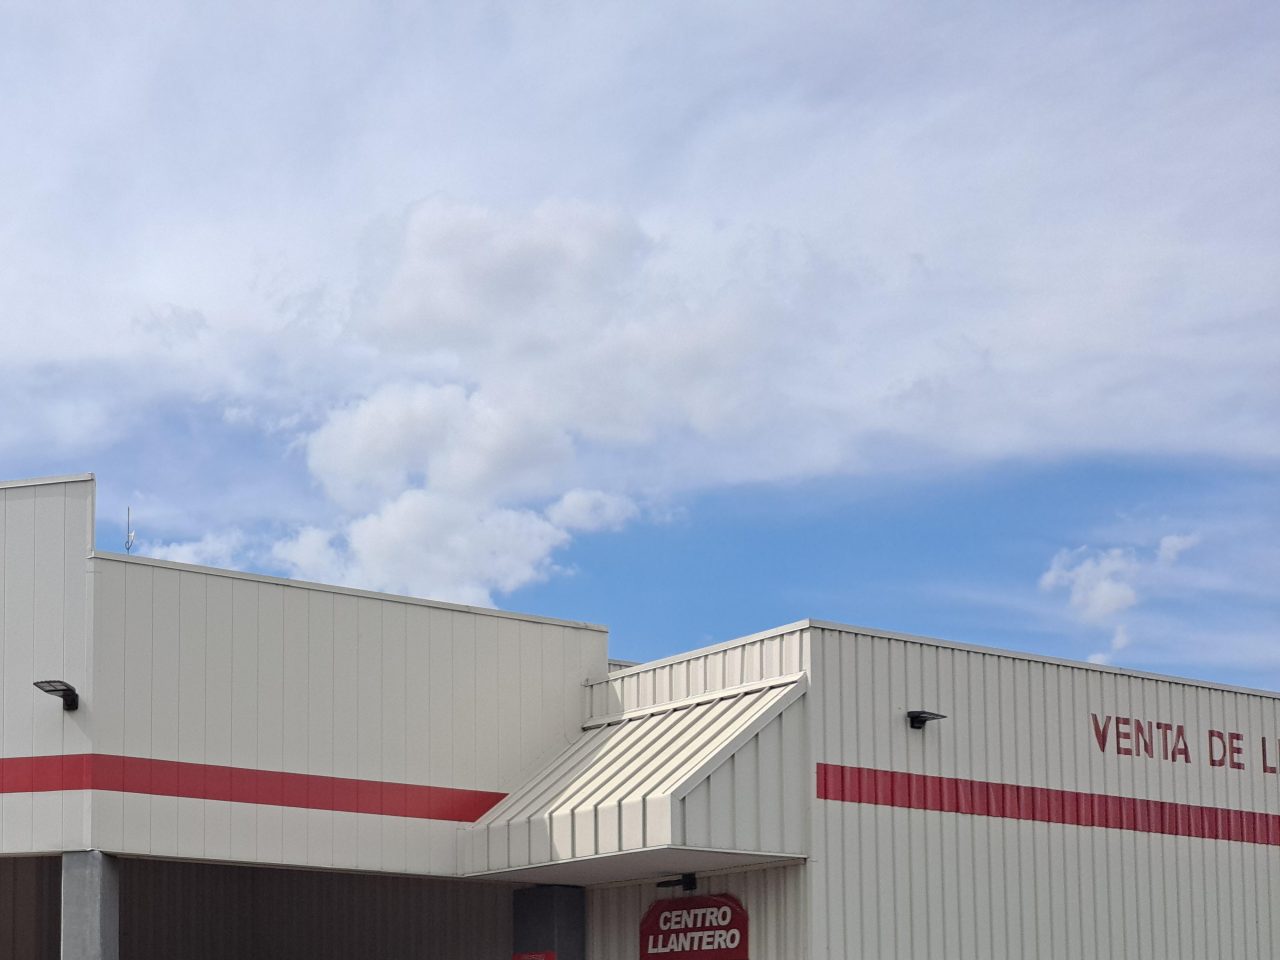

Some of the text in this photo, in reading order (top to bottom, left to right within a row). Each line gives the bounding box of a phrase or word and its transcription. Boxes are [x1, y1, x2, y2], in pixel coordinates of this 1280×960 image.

[1091, 713, 1280, 774] VENTA DE L
[660, 905, 732, 930] CENTRO
[648, 929, 741, 954] LLANTERO
